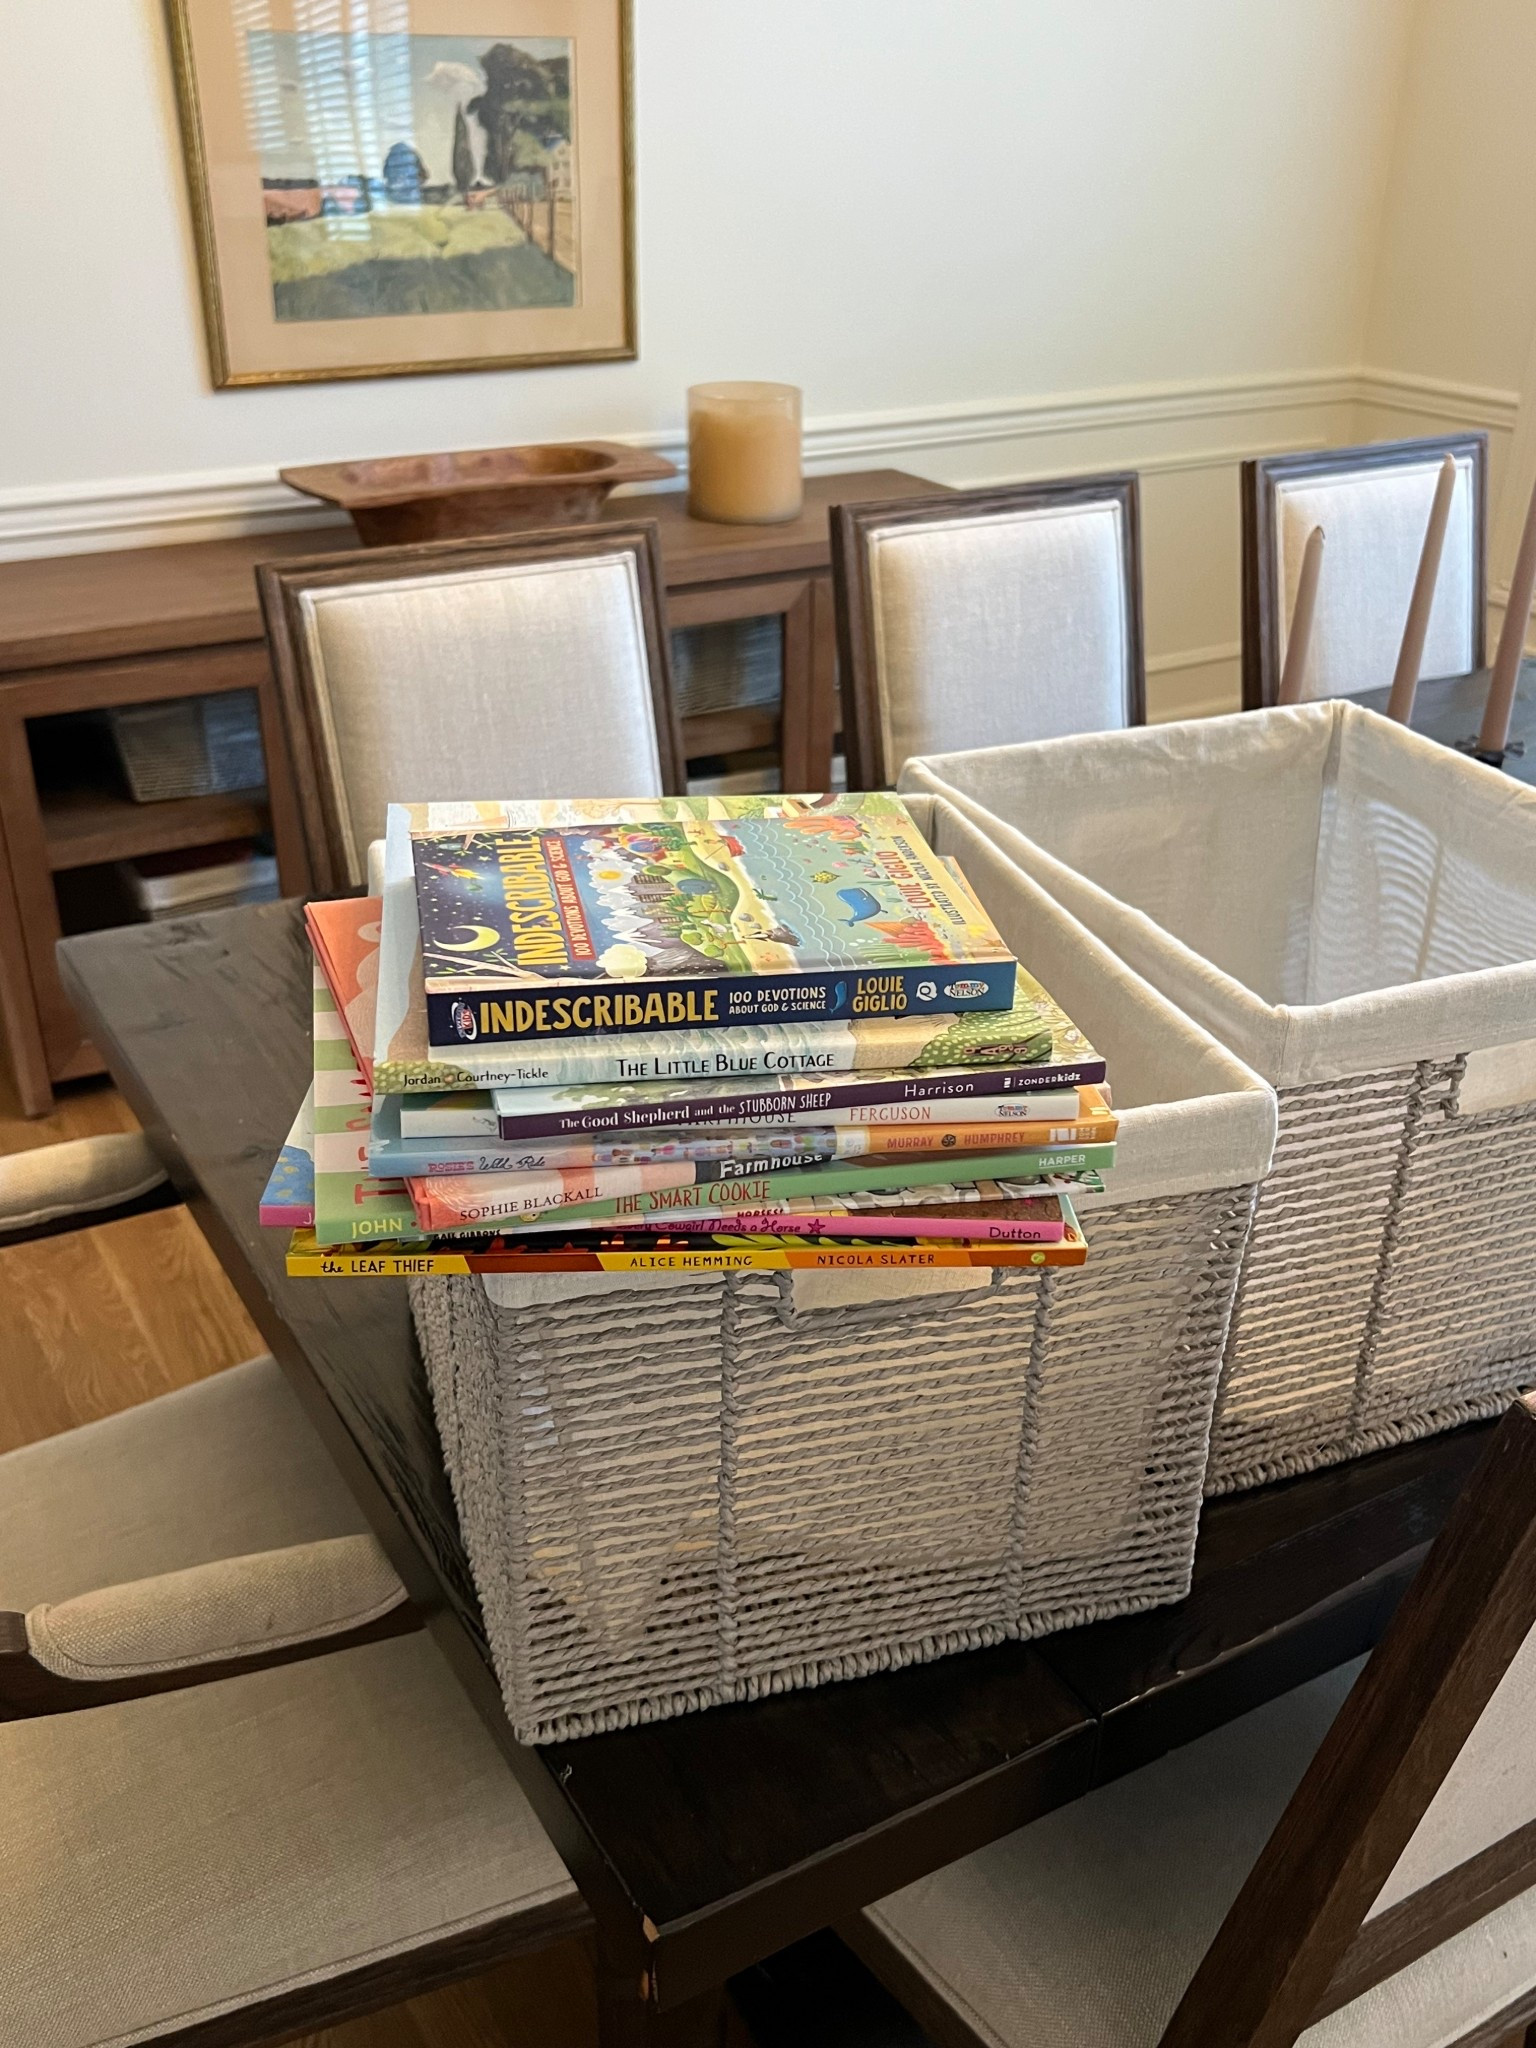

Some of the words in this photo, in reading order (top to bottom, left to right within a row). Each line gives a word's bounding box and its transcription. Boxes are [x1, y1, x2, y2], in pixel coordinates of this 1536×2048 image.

[546, 840, 566, 862] SCIENCE
[875, 851, 914, 879] GIGLIO
[555, 869, 571, 882] GOD
[495, 836, 568, 965] INDESCRIBABLE
[557, 883, 577, 904] ABOUT
[897, 882, 936, 908] LOUIE
[931, 890, 967, 925] ILLUSTRATED
[563, 905, 588, 941] DEVOTIONS
[573, 942, 592, 956] 100
[729, 991, 752, 1004] 100
[757, 986, 826, 1001] DEVOTIONS
[857, 976, 904, 995] LOUIE
[480, 990, 719, 1034] INDESCRIBABLE
[729, 1004, 758, 1015] ABOUT
[761, 1003, 779, 1013] GOD
[791, 1000, 826, 1010] SCIENCE
[852, 994, 908, 1013] GIGLIO
[616, 1059, 648, 1076] THE
[654, 1057, 709, 1075] LITTLE
[716, 1053, 757, 1071] BLUE
[763, 1051, 834, 1069] COTTAGE
[403, 1073, 441, 1087] Jordan
[457, 1067, 549, 1085] Courtney-Tickle
[904, 1081, 975, 1098] Harrison
[559, 1118, 580, 1129] The
[581, 1112, 619, 1129] Good
[624, 1106, 690, 1127] Shepherd
[694, 1106, 714, 1117] and
[719, 1103, 736, 1114] the
[738, 1096, 797, 1115] STUBBORN
[799, 1093, 832, 1109] SHEEP
[850, 1107, 931, 1122] FERGUSON
[887, 1137, 934, 1149] MURRAY
[964, 1132, 1025, 1145] HUMPHREY
[428, 1161, 474, 1173] ROSIE'S
[479, 1156, 513, 1171] Wild
[516, 1156, 547, 1168] Ride
[1038, 1155, 1086, 1167] HARPER
[460, 1202, 519, 1221] SOPHIE
[524, 1187, 603, 1210] BLACKALL
[615, 1194, 642, 1214] THE
[650, 1187, 702, 1210] SMART
[708, 1180, 771, 1205] COOKIE
[352, 1218, 403, 1238] JOHN
[709, 1219, 747, 1232] Needs
[760, 1217, 801, 1233] Horse
[989, 1227, 1041, 1239] Dutton
[321, 1261, 344, 1274] the
[351, 1260, 386, 1272] LEAF
[394, 1259, 435, 1272] THIEF
[630, 1257, 676, 1267] ALICE
[683, 1256, 753, 1266] HEMMING
[817, 1254, 873, 1265] NICOLA
[880, 1254, 935, 1265] SLATER
